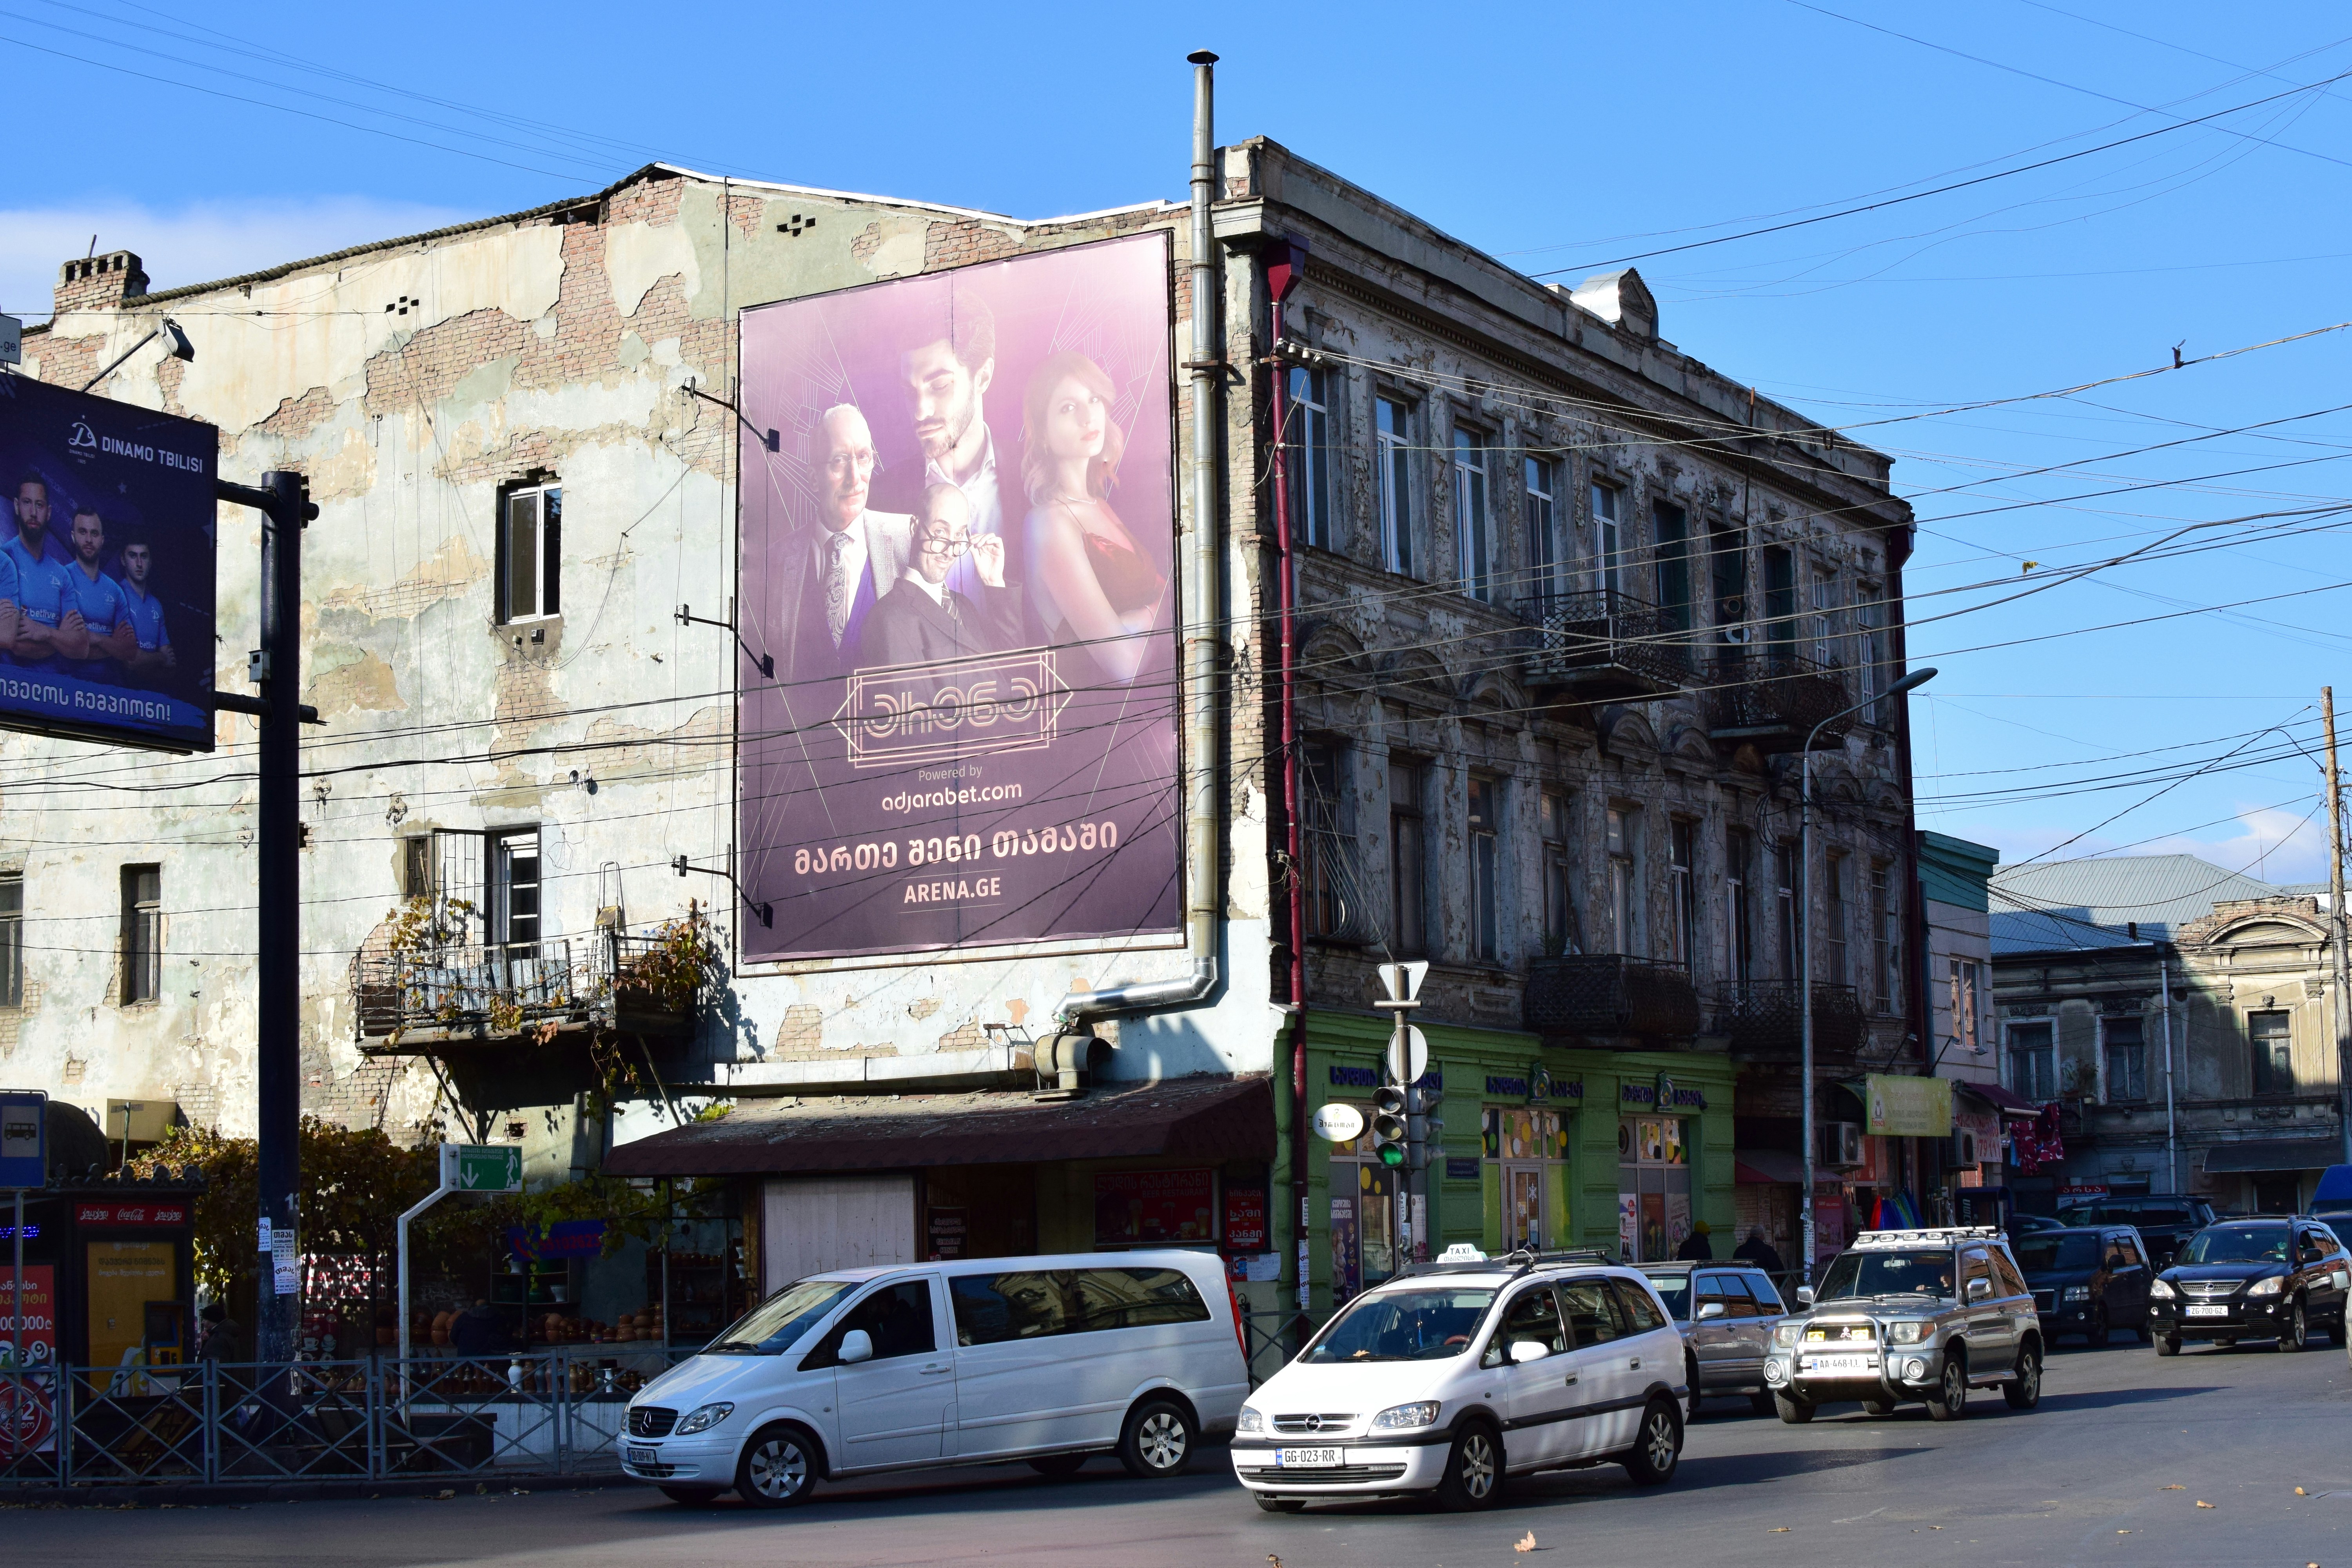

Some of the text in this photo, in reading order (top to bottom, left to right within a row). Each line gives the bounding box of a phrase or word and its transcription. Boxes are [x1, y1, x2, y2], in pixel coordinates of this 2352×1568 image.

[102, 436, 203, 473] DINAMO TBILISI
[75, 690, 171, 721] ჩემპიონი!
[918, 764, 983, 782] Powered by
[882, 782, 1022, 814] adjarabet.com
[794, 821, 1118, 875] მართე შენი თამაში
[904, 877, 1001, 903] ARENA.GE
[1330, 1066, 1377, 1086] სუფთა
[1486, 1076, 1584, 1098] სუფთა სახლი
[1622, 1085, 1703, 1106] სუფთა სახლი
[1871, 1118, 1886, 1127] Frosch
[1097, 1172, 1209, 1191] ლუდის რესტორანი
[1142, 1187, 1209, 1198] BEER RESTAURANT
[275, 1266, 295, 1275] თმას
[35, 1343, 45, 1356] 9
[1820, 1359, 1861, 1369] AA-468-LL
[1285, 1450, 1335, 1463] GG-023-RR
